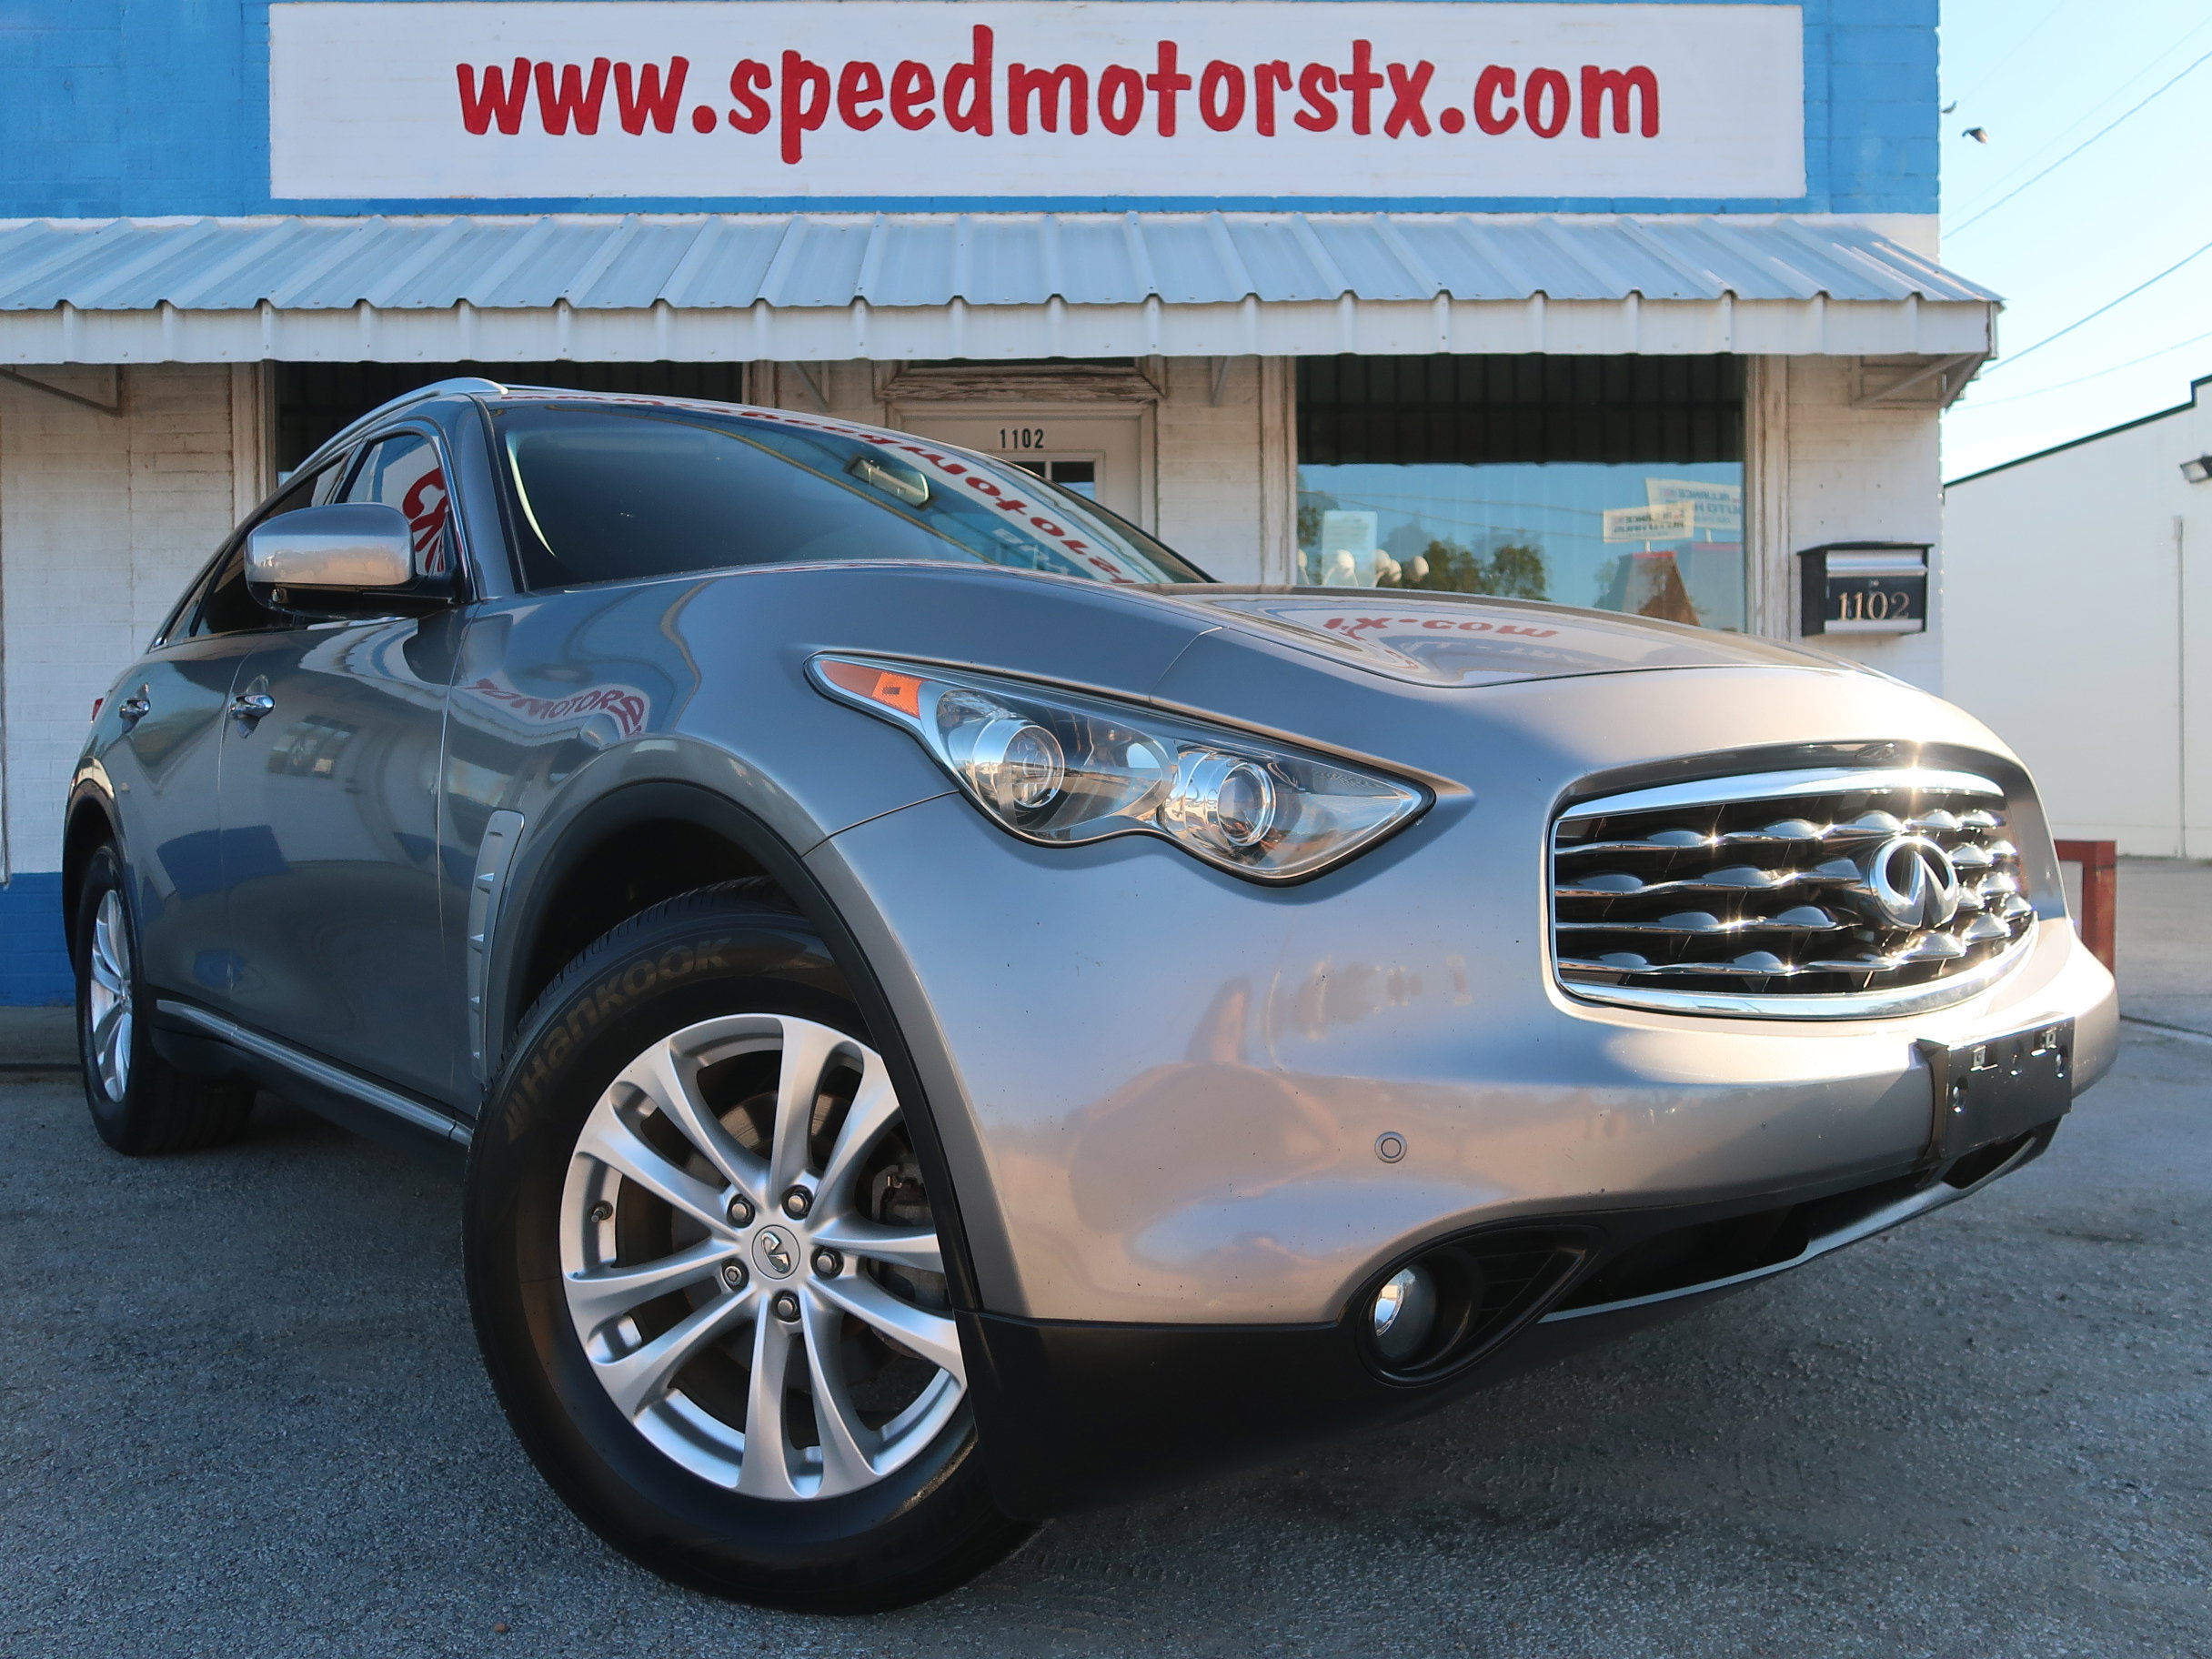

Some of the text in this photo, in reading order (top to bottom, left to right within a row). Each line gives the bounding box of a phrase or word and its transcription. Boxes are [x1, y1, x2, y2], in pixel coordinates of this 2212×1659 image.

[456, 24, 1659, 164] www.speedmotorstx.com
[1000, 428, 1044, 448] 1102
[1837, 591, 1911, 620] 1102
